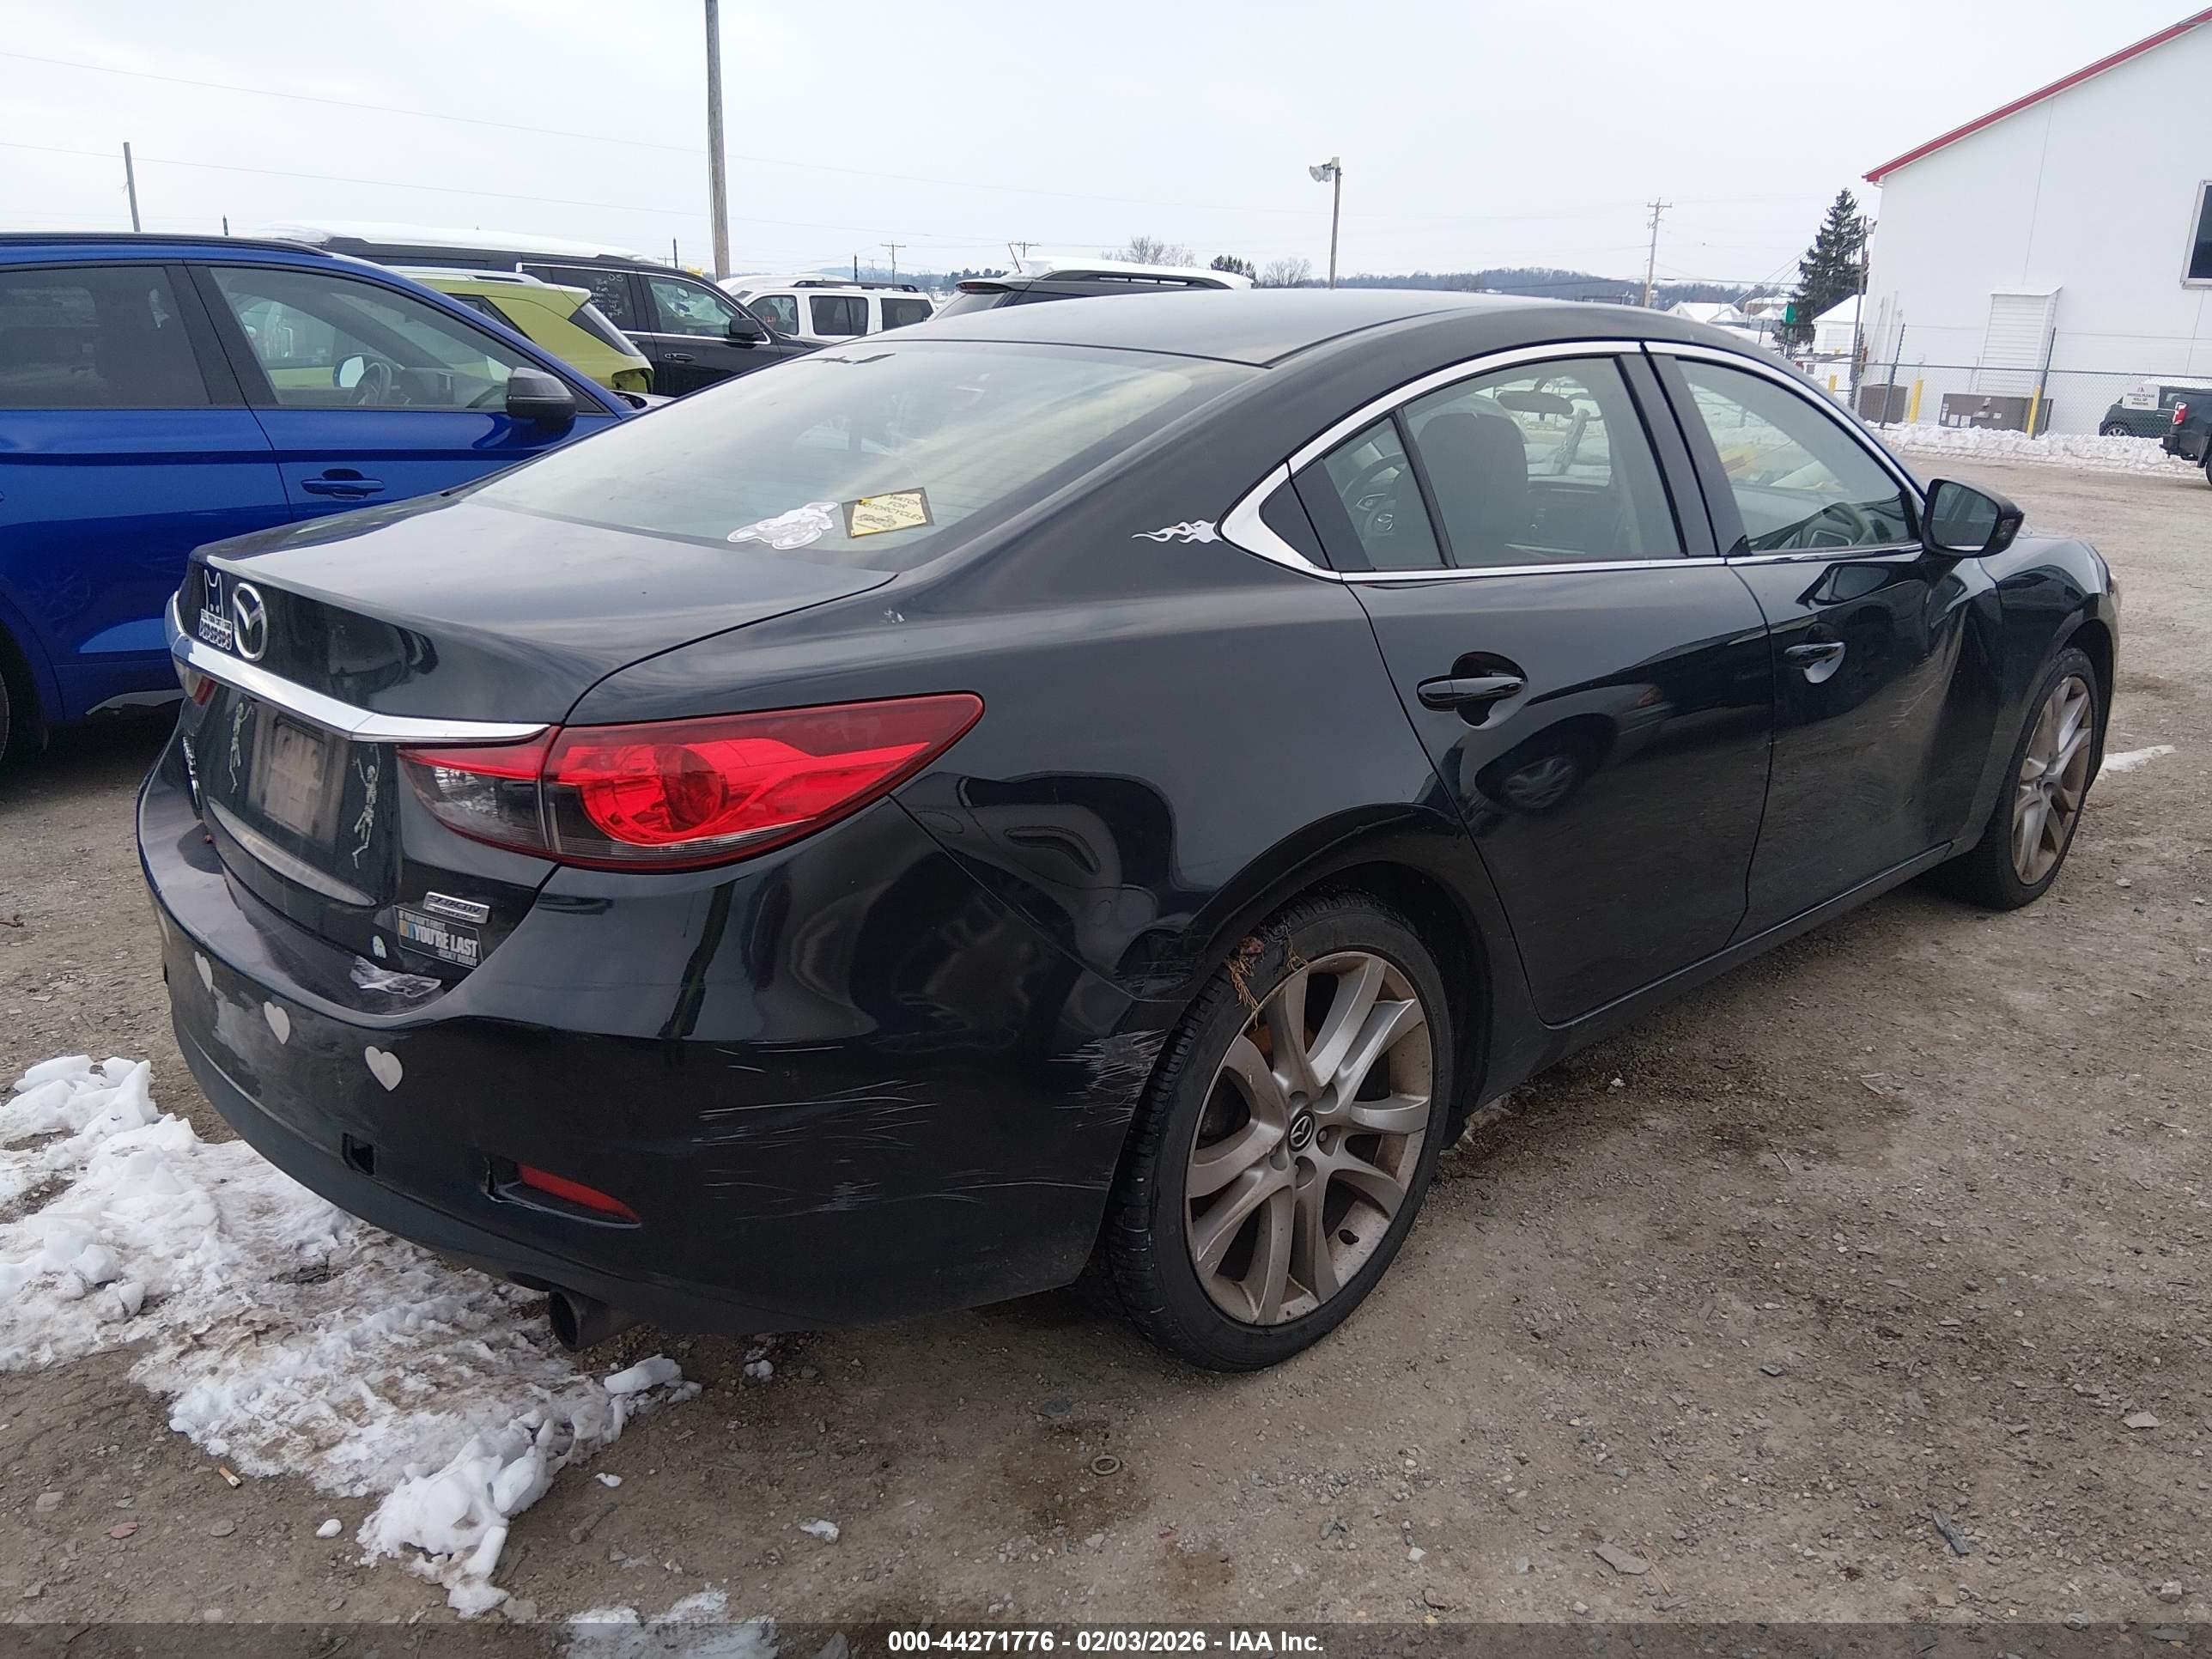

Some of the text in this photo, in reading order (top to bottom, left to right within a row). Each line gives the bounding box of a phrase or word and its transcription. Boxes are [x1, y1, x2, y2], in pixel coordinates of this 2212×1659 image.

[861, 501, 924, 521] OTORCYCLES
[414, 924, 478, 957] YOU'RE LAST
